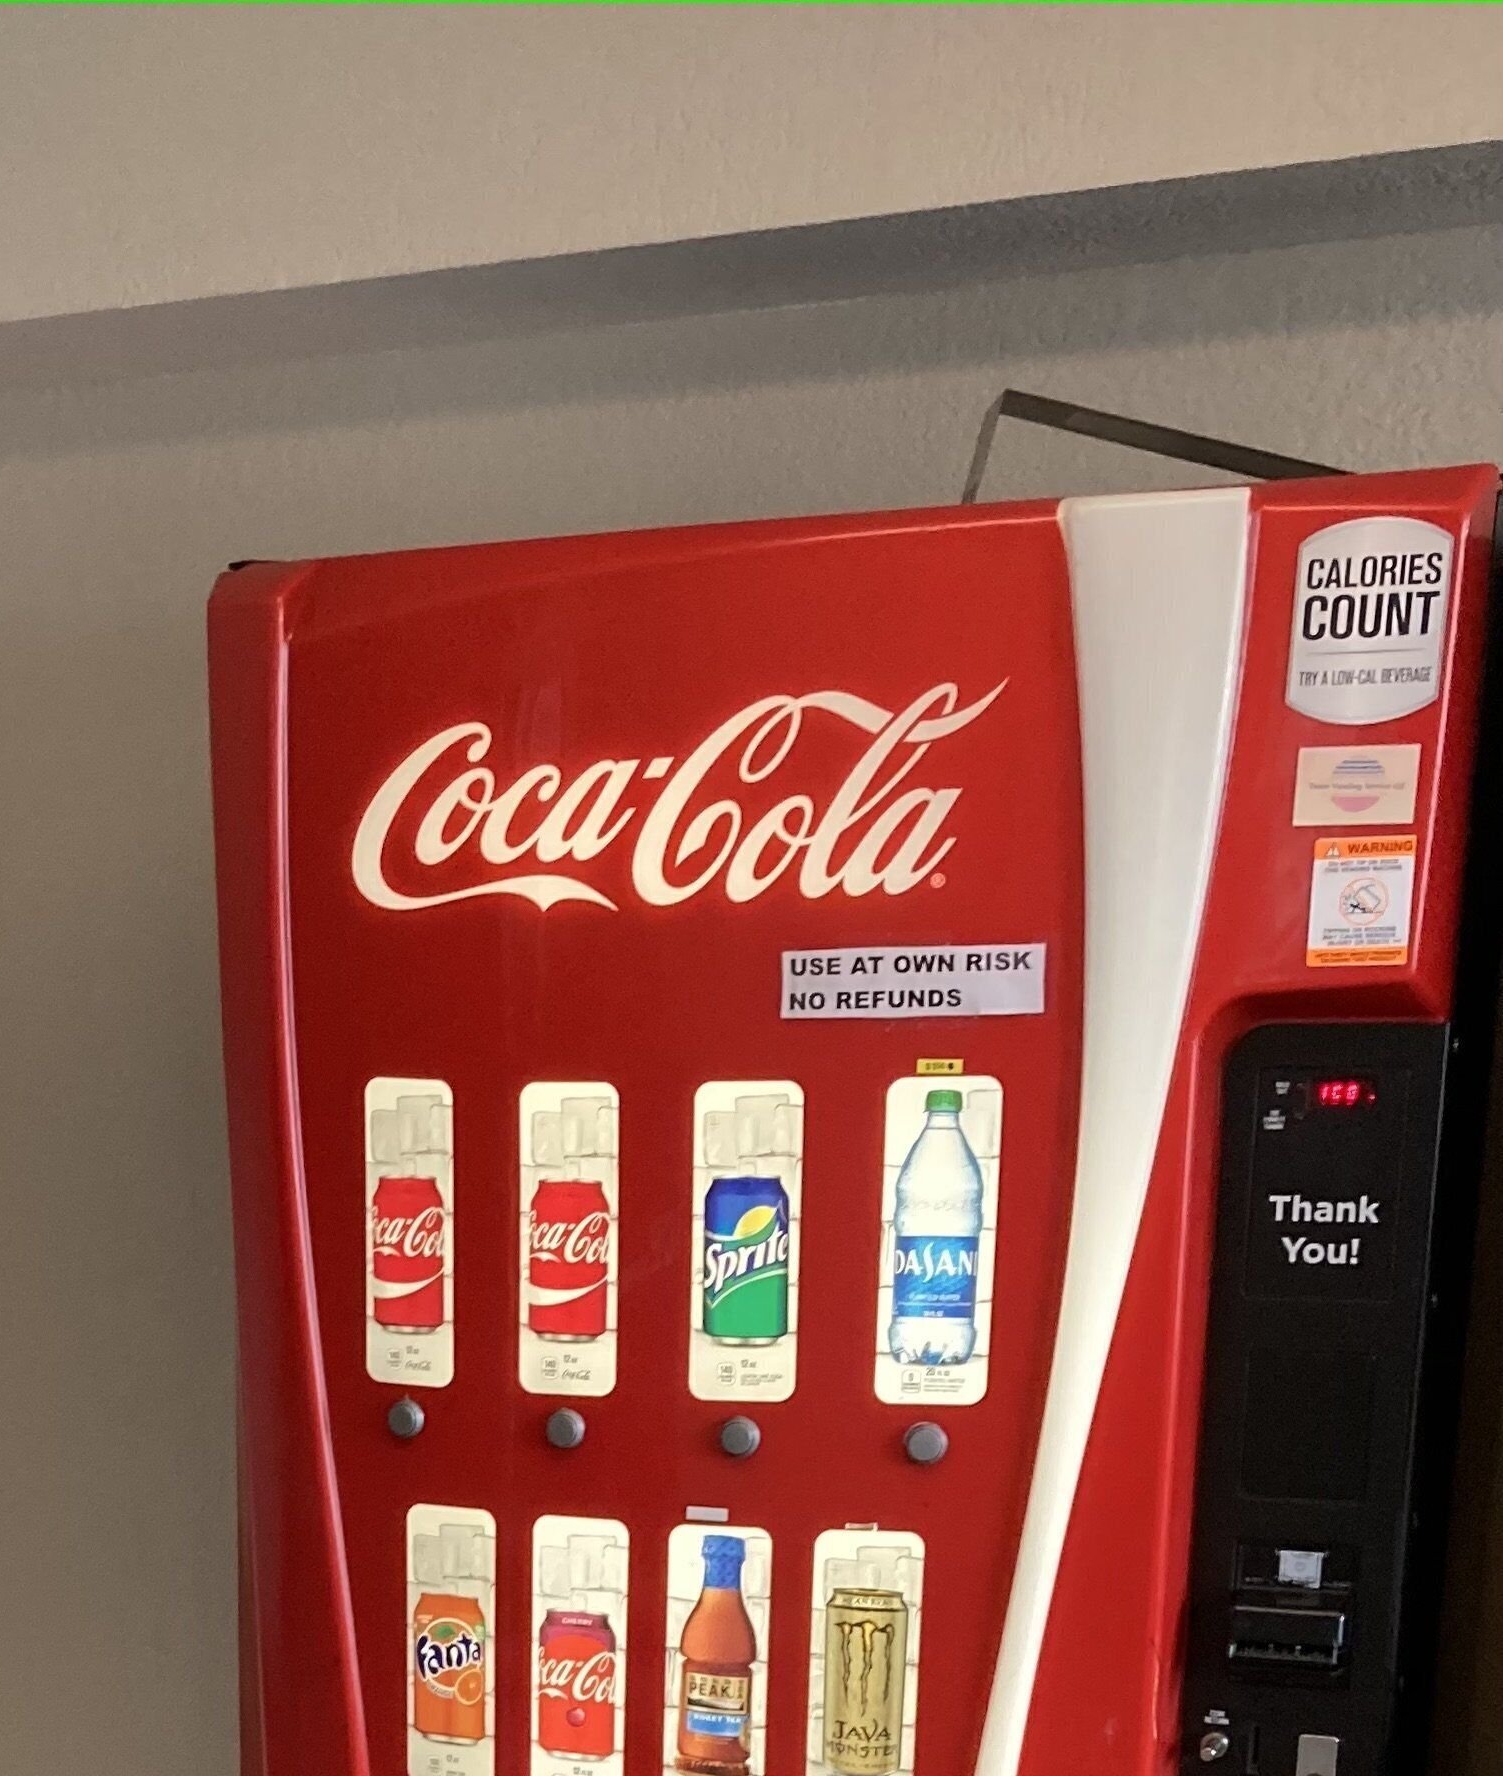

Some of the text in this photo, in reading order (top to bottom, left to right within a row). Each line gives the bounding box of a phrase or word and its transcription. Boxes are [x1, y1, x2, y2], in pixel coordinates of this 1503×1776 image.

[1306, 552, 1443, 590] CALORIES
[1302, 590, 1441, 641] COUNT
[1299, 666, 1433, 687] TRY A LOW-CAL BEVERAGE
[352, 676, 1009, 912] Coca-Cola
[1347, 840, 1413, 854] WARNING
[790, 951, 1032, 977] USE AT OWN RISK
[789, 989, 963, 1011] NO REFUNDS
[1269, 1194, 1380, 1223] Thank
[704, 1221, 789, 1294] Sprite
[1281, 1236, 1361, 1265] You!
[689, 1681, 730, 1698] PEAK
[832, 1718, 891, 1743] JAVA
